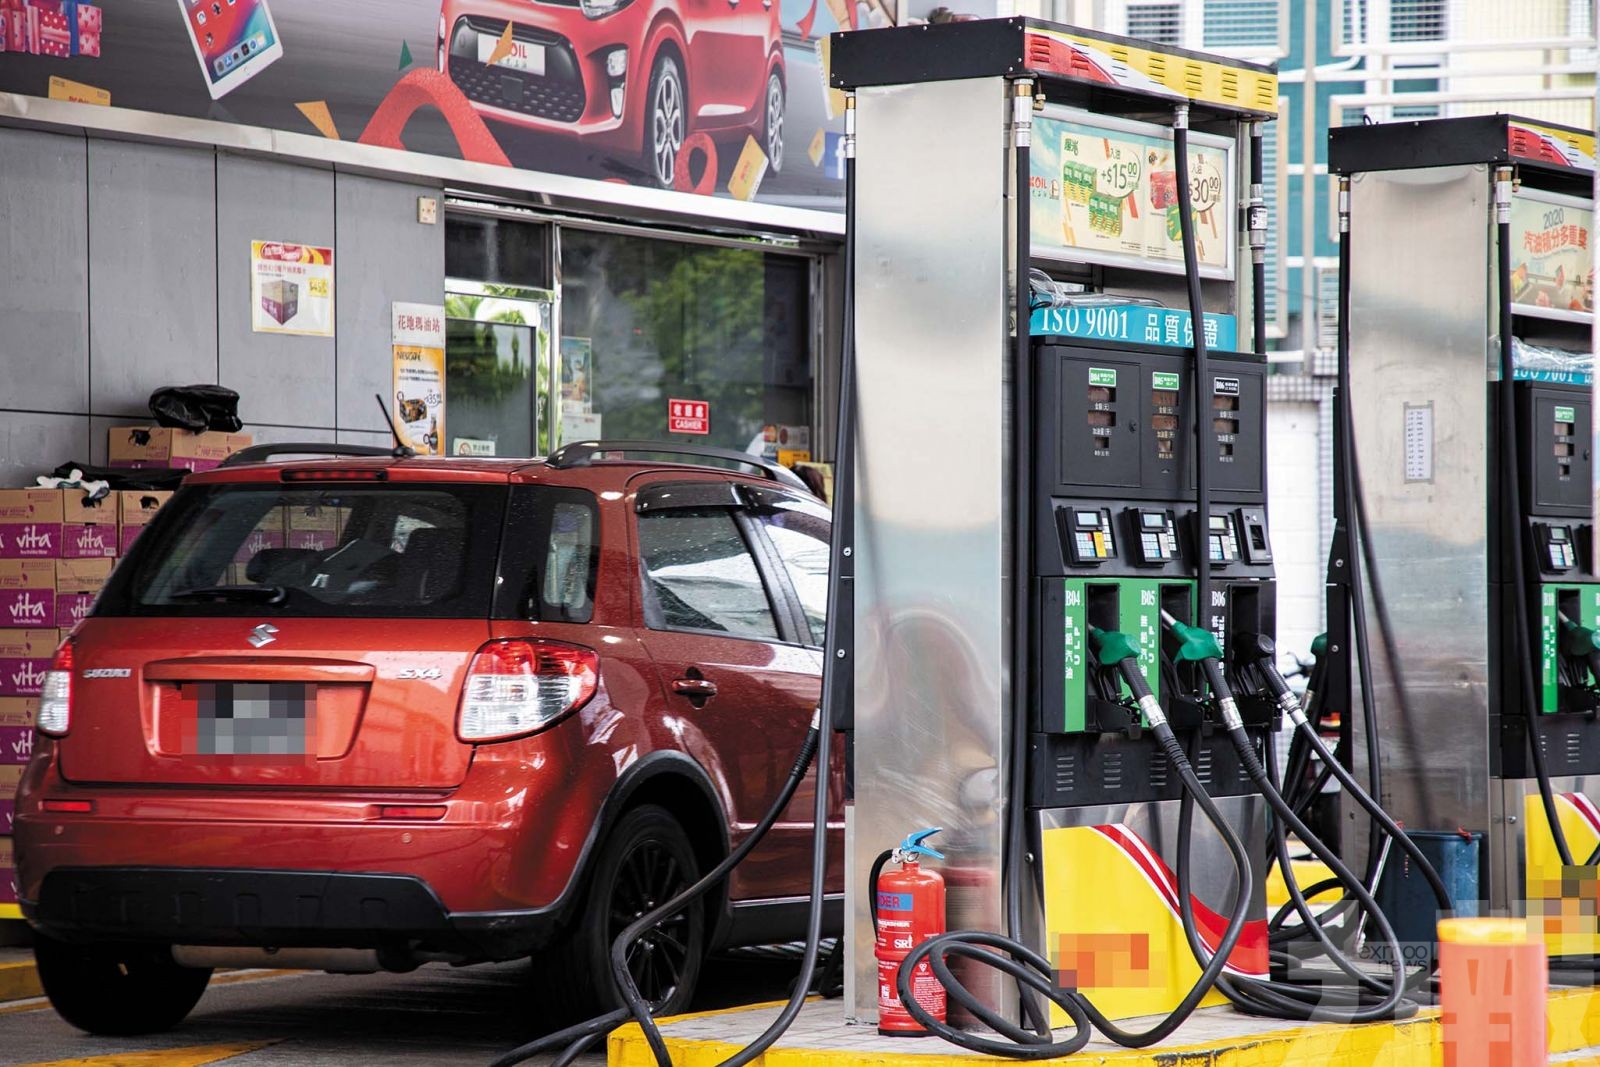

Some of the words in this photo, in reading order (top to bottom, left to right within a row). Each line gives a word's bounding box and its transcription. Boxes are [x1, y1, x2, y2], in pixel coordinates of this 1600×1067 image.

[1543, 208, 1564, 229] 2020
[398, 314, 440, 333] 花地瑪油站
[1042, 308, 1080, 334] ISO
[1086, 308, 1128, 339] 9001
[16, 525, 52, 548] vita
[77, 528, 104, 548] vita
[9, 592, 46, 617] vita
[70, 597, 92, 618] vit
[1065, 590, 1080, 606] B04
[1141, 590, 1155, 606] B05
[1211, 591, 1226, 606] B06
[397, 665, 442, 680] SX4
